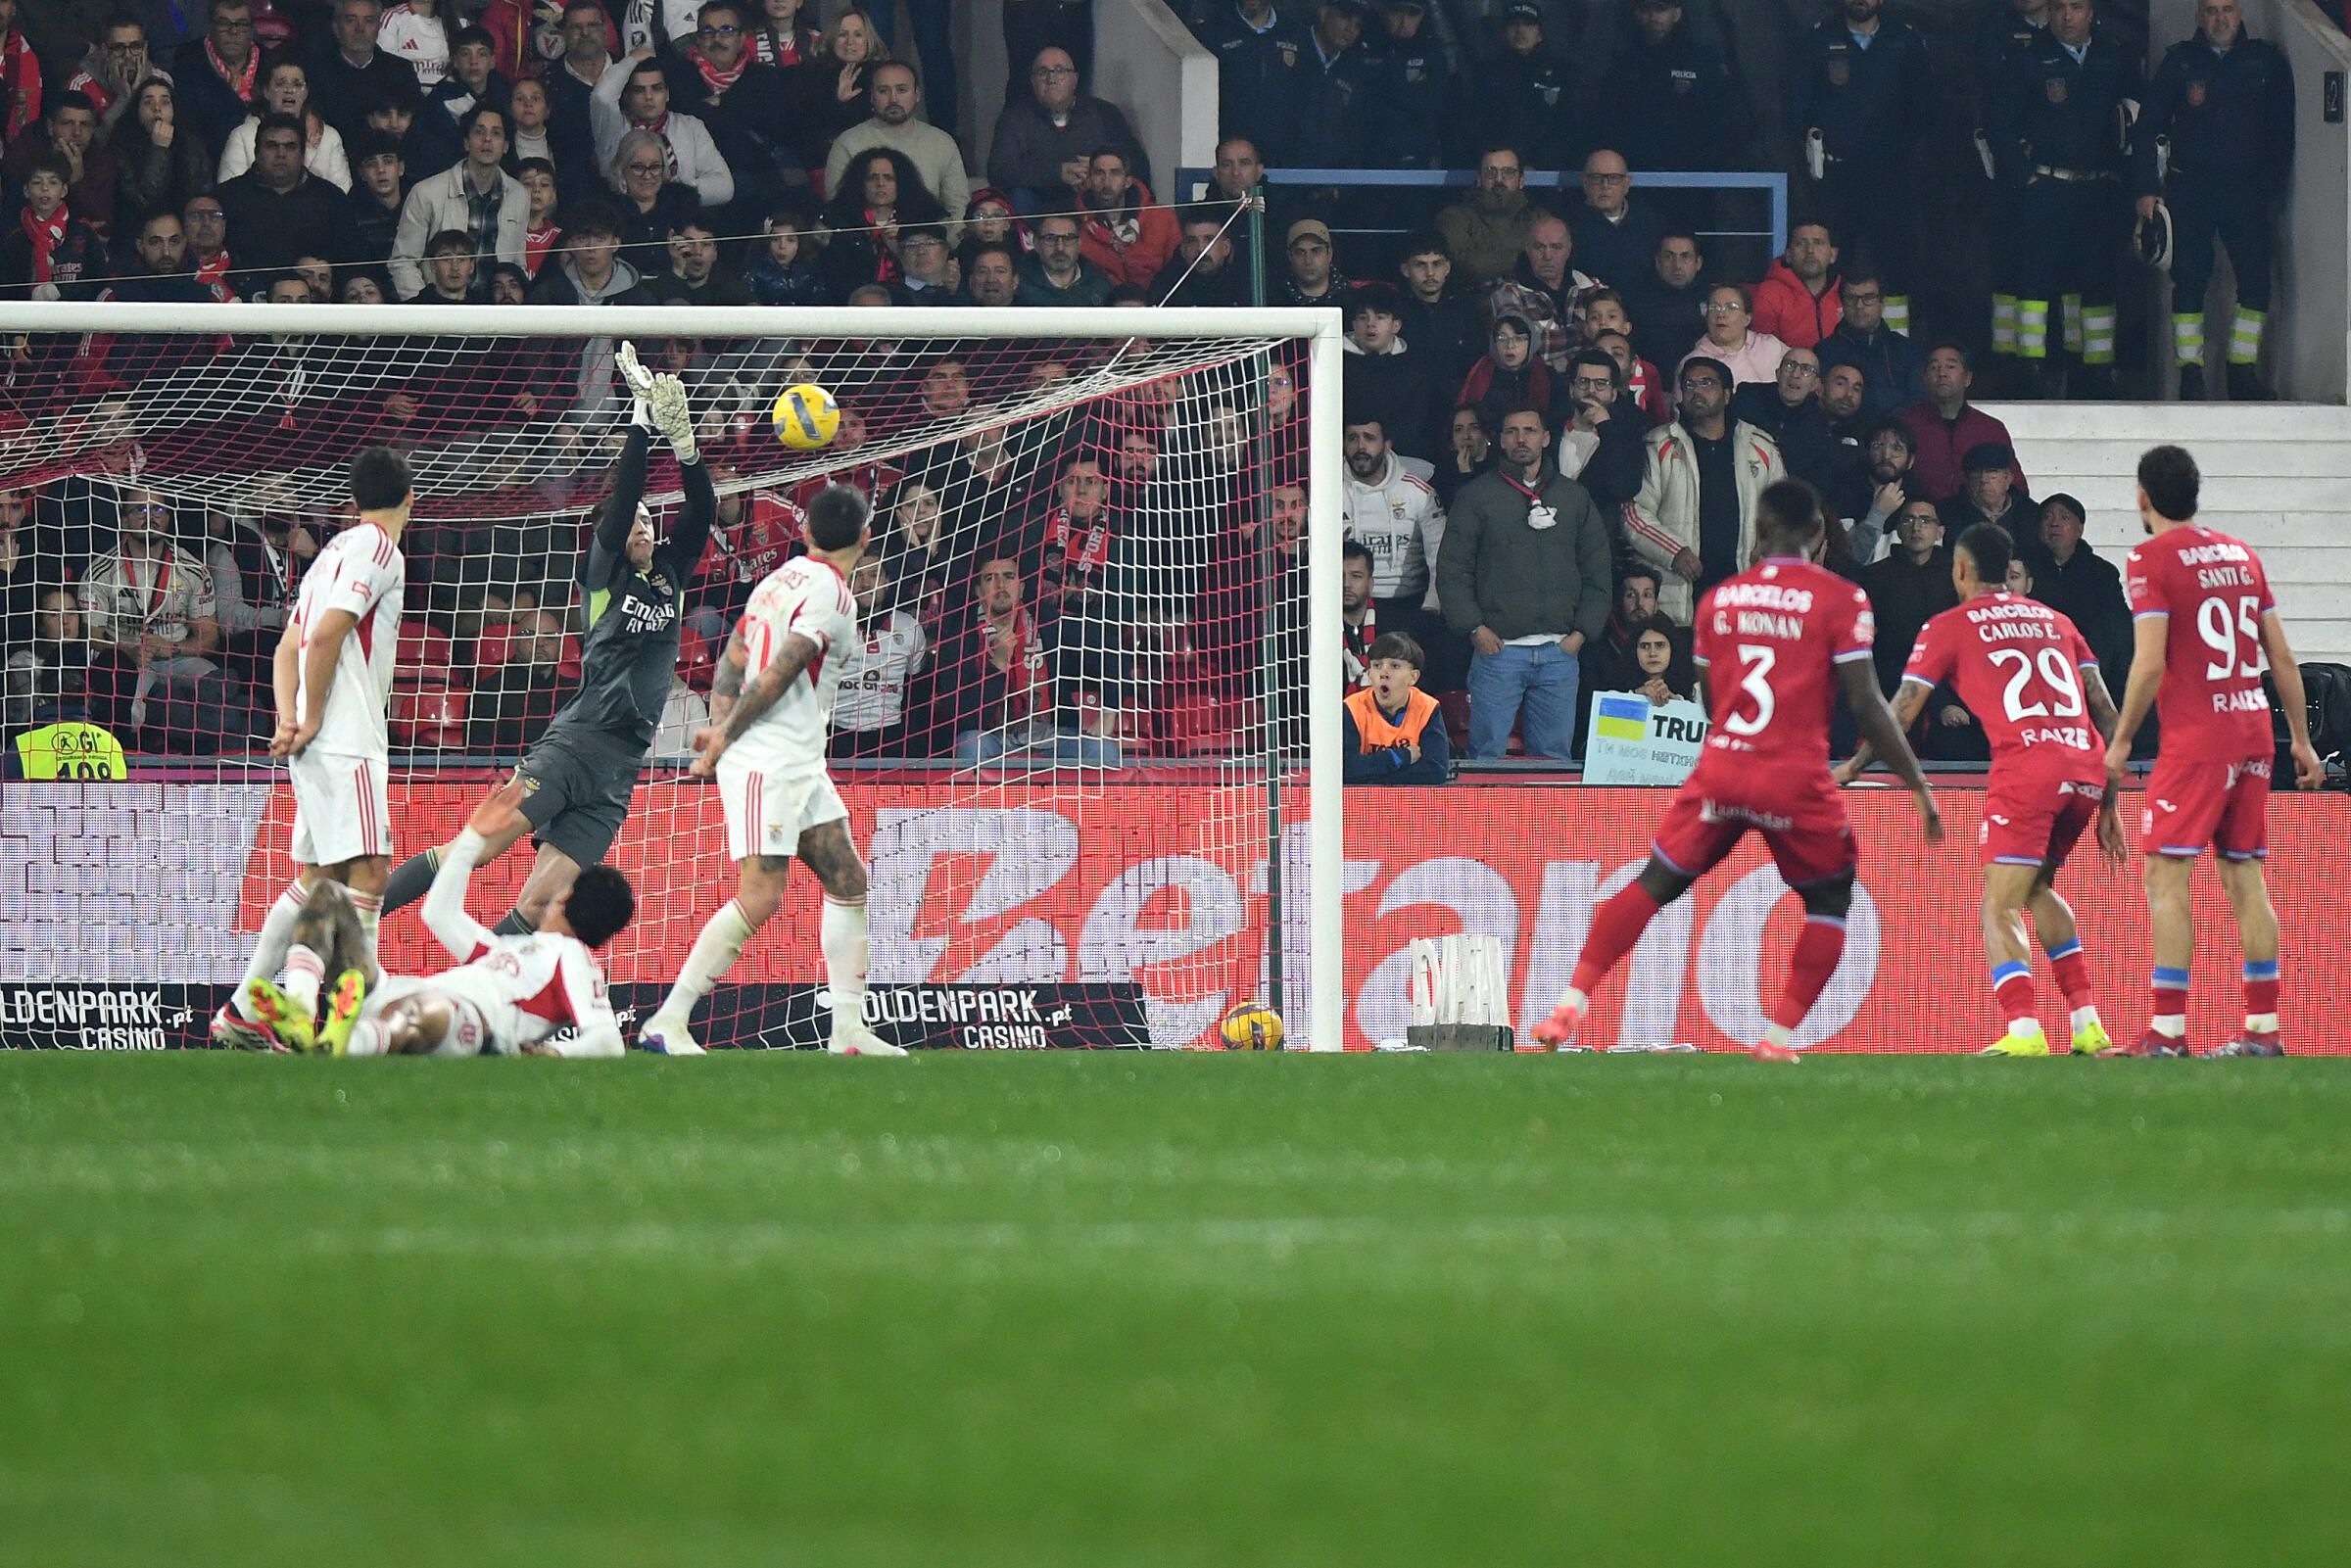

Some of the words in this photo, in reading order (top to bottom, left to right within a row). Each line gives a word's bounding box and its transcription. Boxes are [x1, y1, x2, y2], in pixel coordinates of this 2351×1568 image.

[2197, 567, 2239, 589] SANTI
[1714, 584, 1813, 613] BARCELOS
[1737, 610, 1803, 641] KONAN
[1967, 604, 2055, 624] BARCELOS
[1979, 623, 2045, 642] CARLOS
[2197, 595, 2261, 681] 95
[1724, 643, 1776, 736] 3
[1988, 646, 2083, 723] 29
[2021, 728, 2091, 750] RAIZE
[82, 1027, 166, 1051] CASINO
[963, 1025, 1047, 1050] CASINO
